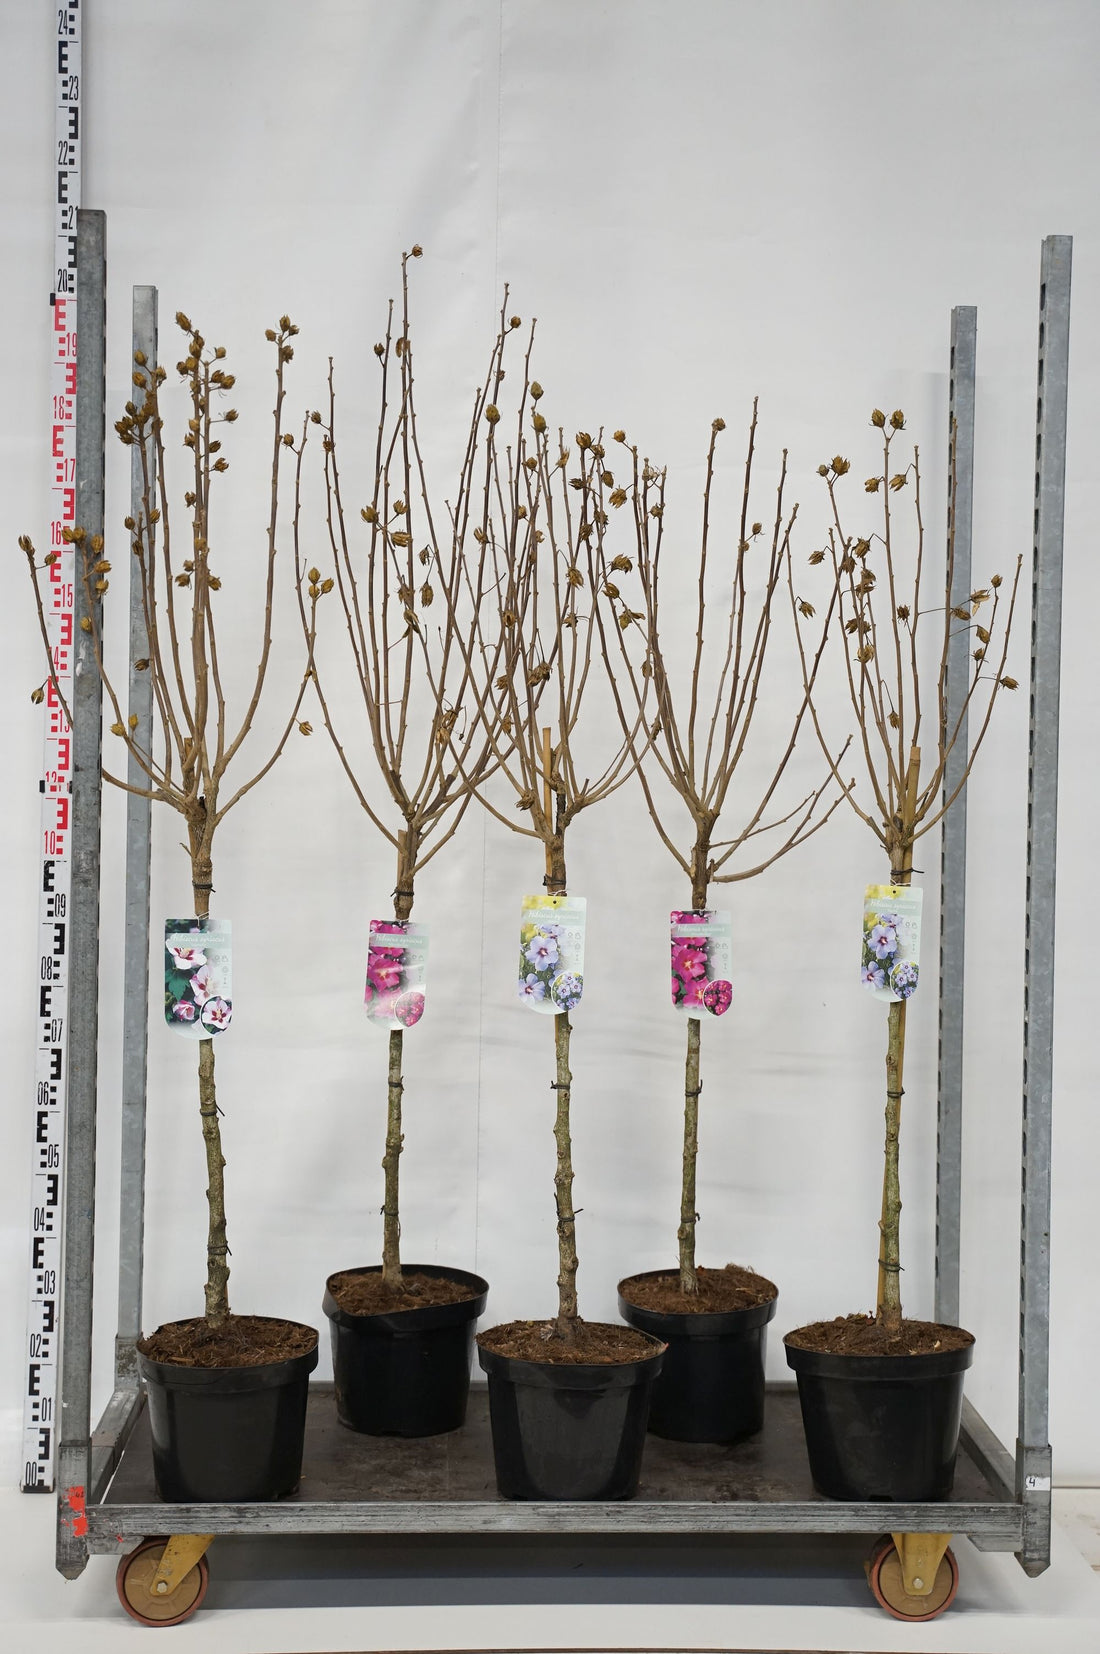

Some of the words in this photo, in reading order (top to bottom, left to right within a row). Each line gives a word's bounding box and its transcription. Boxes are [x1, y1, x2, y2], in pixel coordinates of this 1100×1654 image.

[58, 9, 68, 35] 24
[69, 75, 79, 101] 23
[58, 140, 68, 165] 22
[57, 268, 68, 293] 20
[66, 332, 77, 357] 19
[53, 395, 65, 420] 18
[64, 458, 76, 482] 17
[51, 521, 62, 545] 16
[61, 584, 73, 608] 15
[44, 830, 56, 855] 10
[54, 893, 66, 918] 09
[41, 956, 52, 981] 08
[51, 1018, 63, 1043] 07
[37, 1081, 49, 1106] 06
[47, 1144, 60, 1168] 05
[33, 1207, 45, 1231] 04
[44, 1270, 56, 1295] 03
[30, 1333, 42, 1358] 02
[41, 1397, 51, 1422] 01
[25, 1461, 37, 1486] 00
[1028, 1477, 1036, 1488] 4
